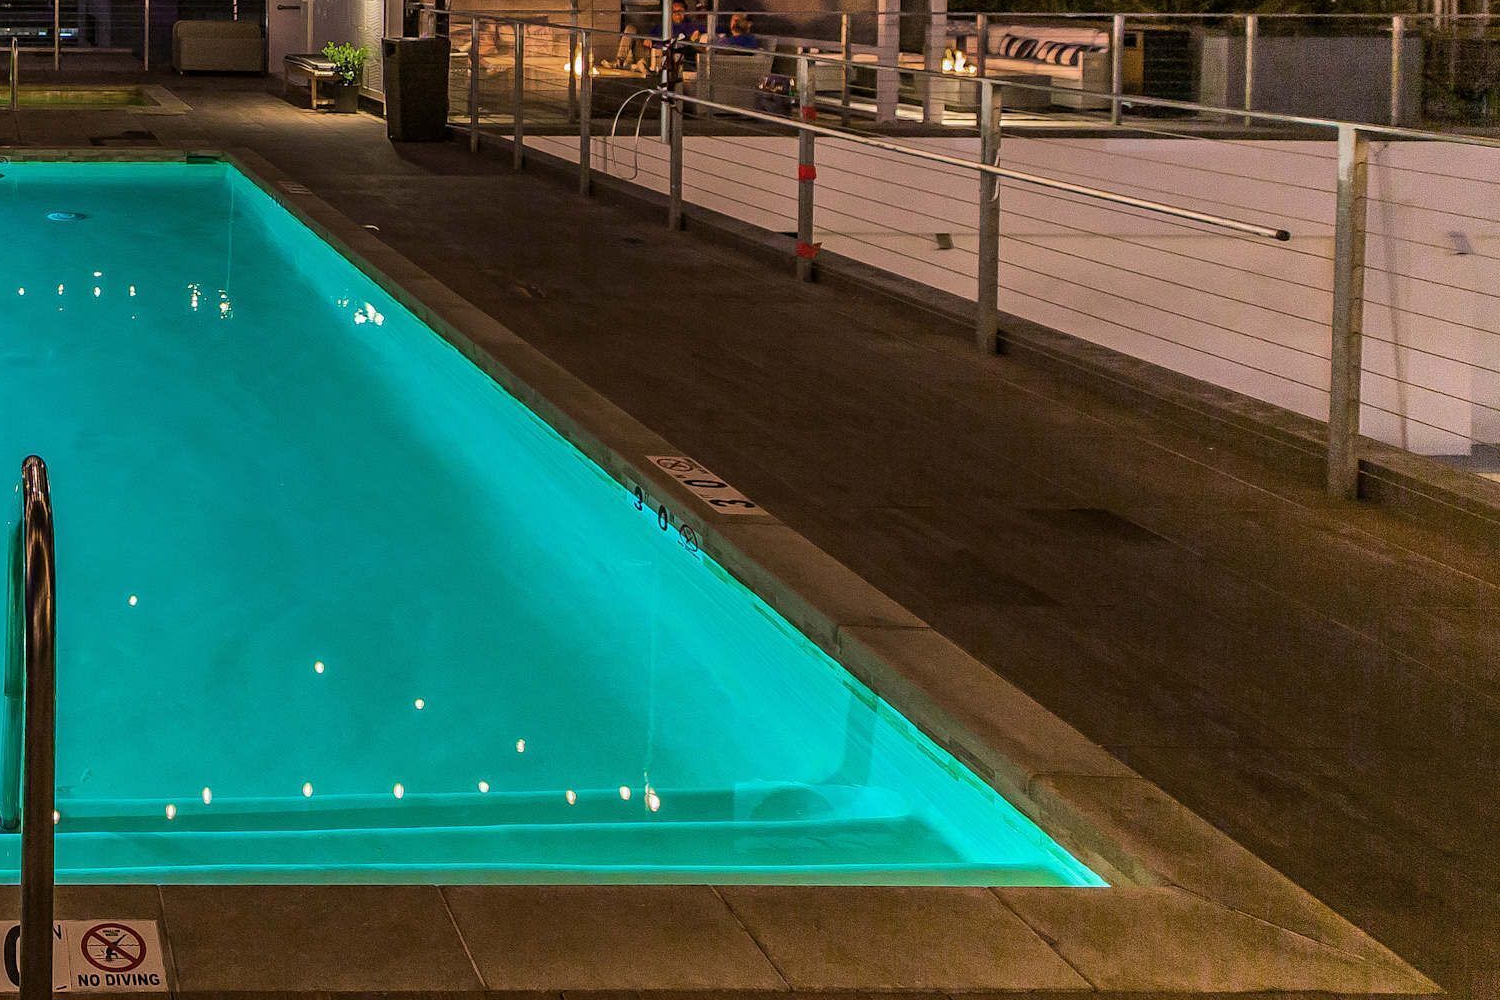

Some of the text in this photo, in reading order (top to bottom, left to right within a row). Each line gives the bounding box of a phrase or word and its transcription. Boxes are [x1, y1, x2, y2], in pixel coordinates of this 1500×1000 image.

[634, 486, 643, 511] 3
[658, 505, 668, 531] 0
[708, 499, 755, 508] 3
[78, 973, 161, 987] NO DIVING
